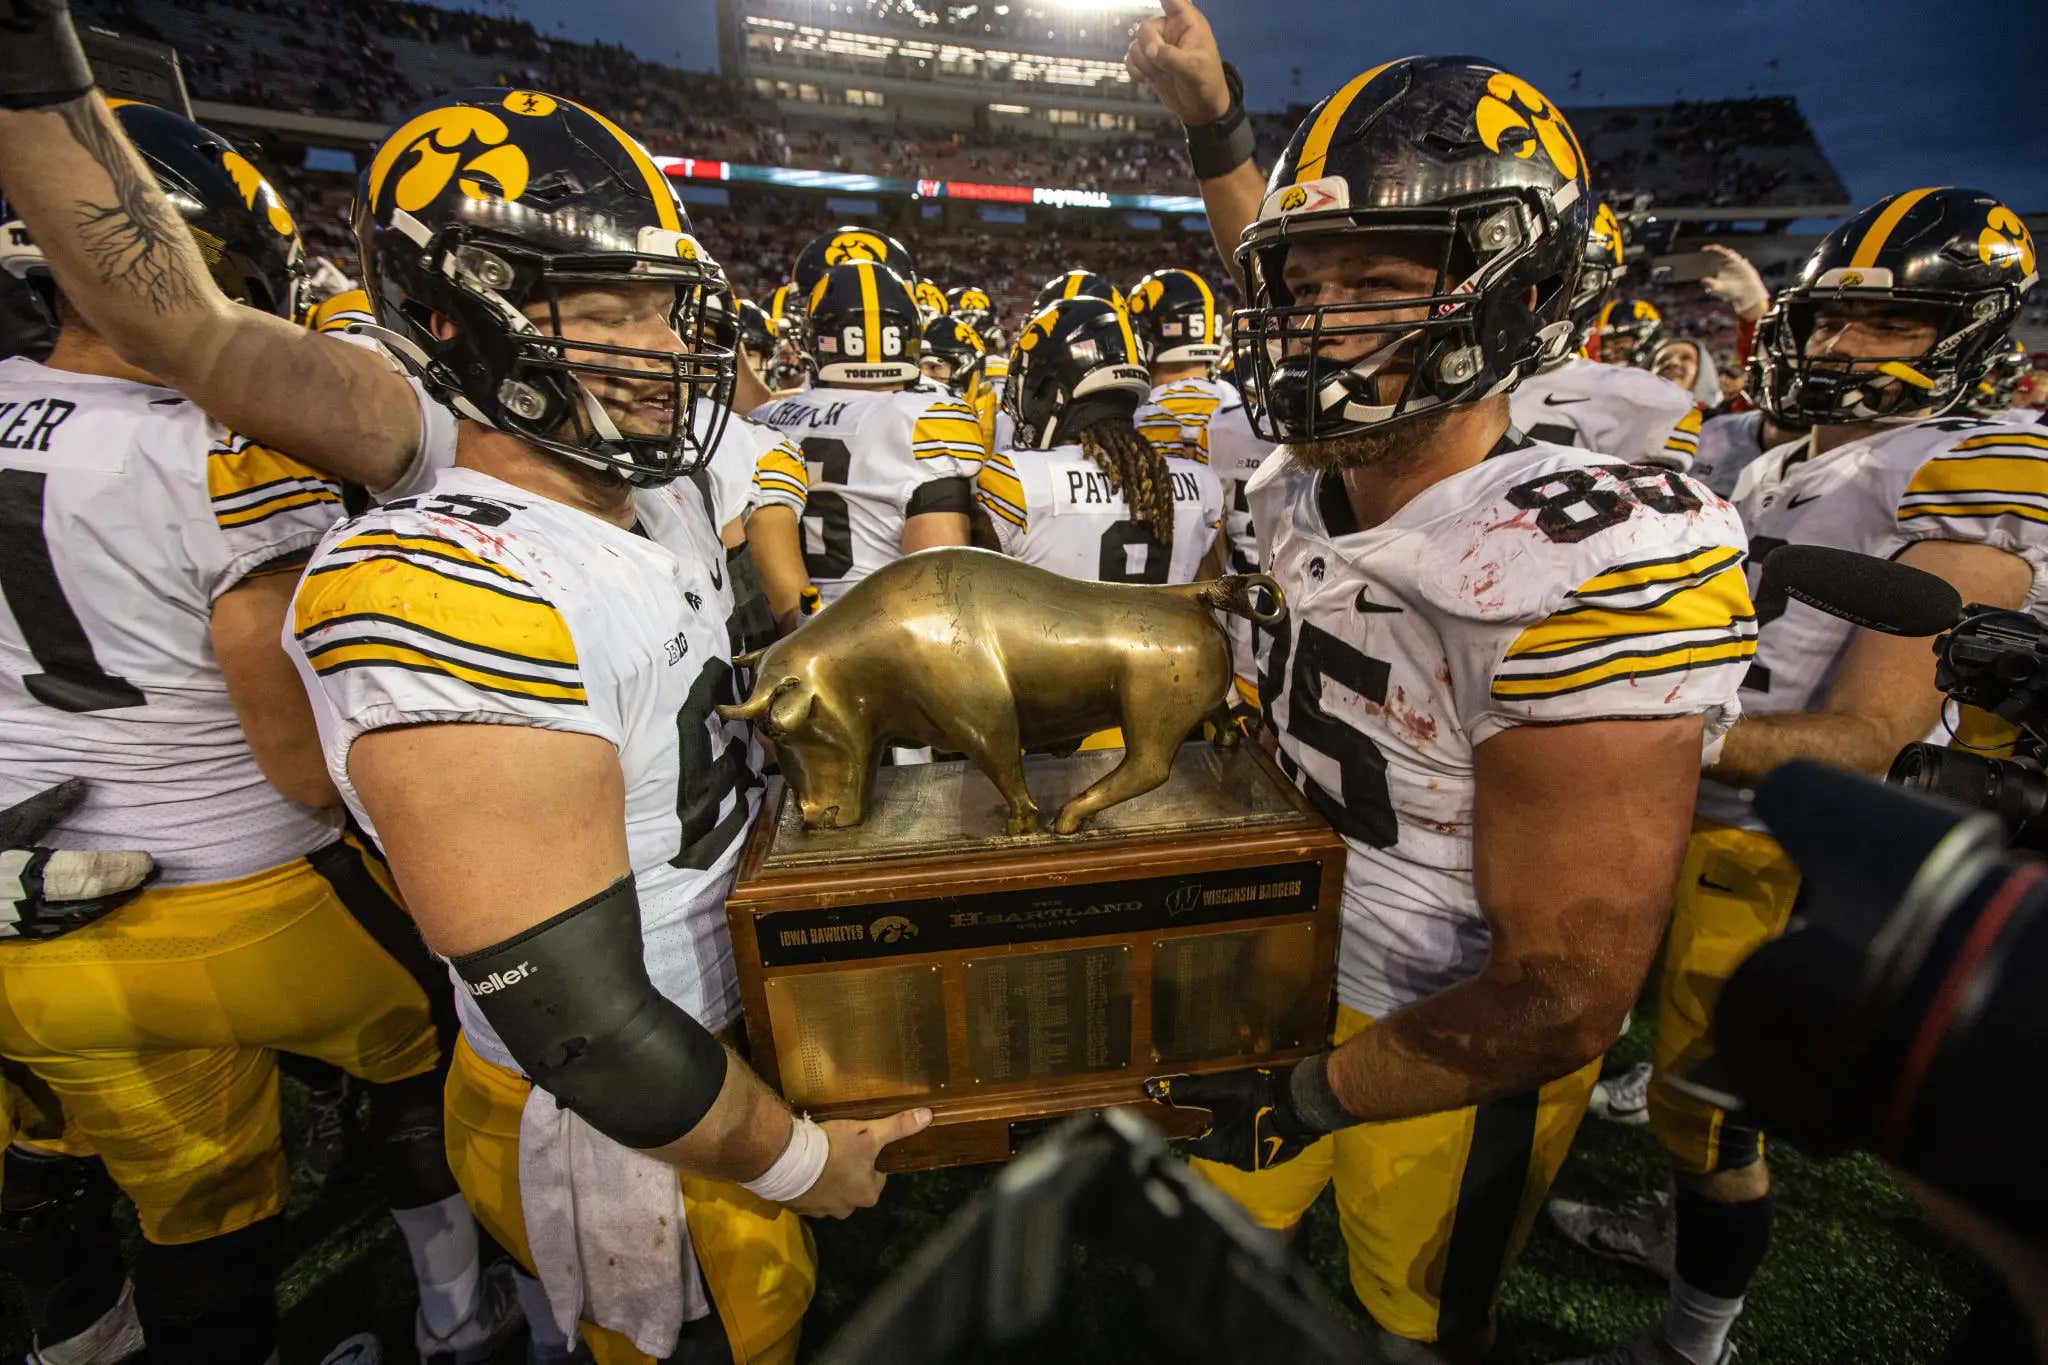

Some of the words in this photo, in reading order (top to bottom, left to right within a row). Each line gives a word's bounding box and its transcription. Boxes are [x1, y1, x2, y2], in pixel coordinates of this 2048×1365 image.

[843, 326, 901, 357] 66
[844, 368, 902, 378] TOGETHER
[1203, 886, 1256, 906] WISCONSIN
[1259, 880, 1302, 900] BADGERS
[780, 928, 808, 947] IOWA
[811, 924, 864, 945] HAWKEYES
[463, 960, 529, 996] ueller
